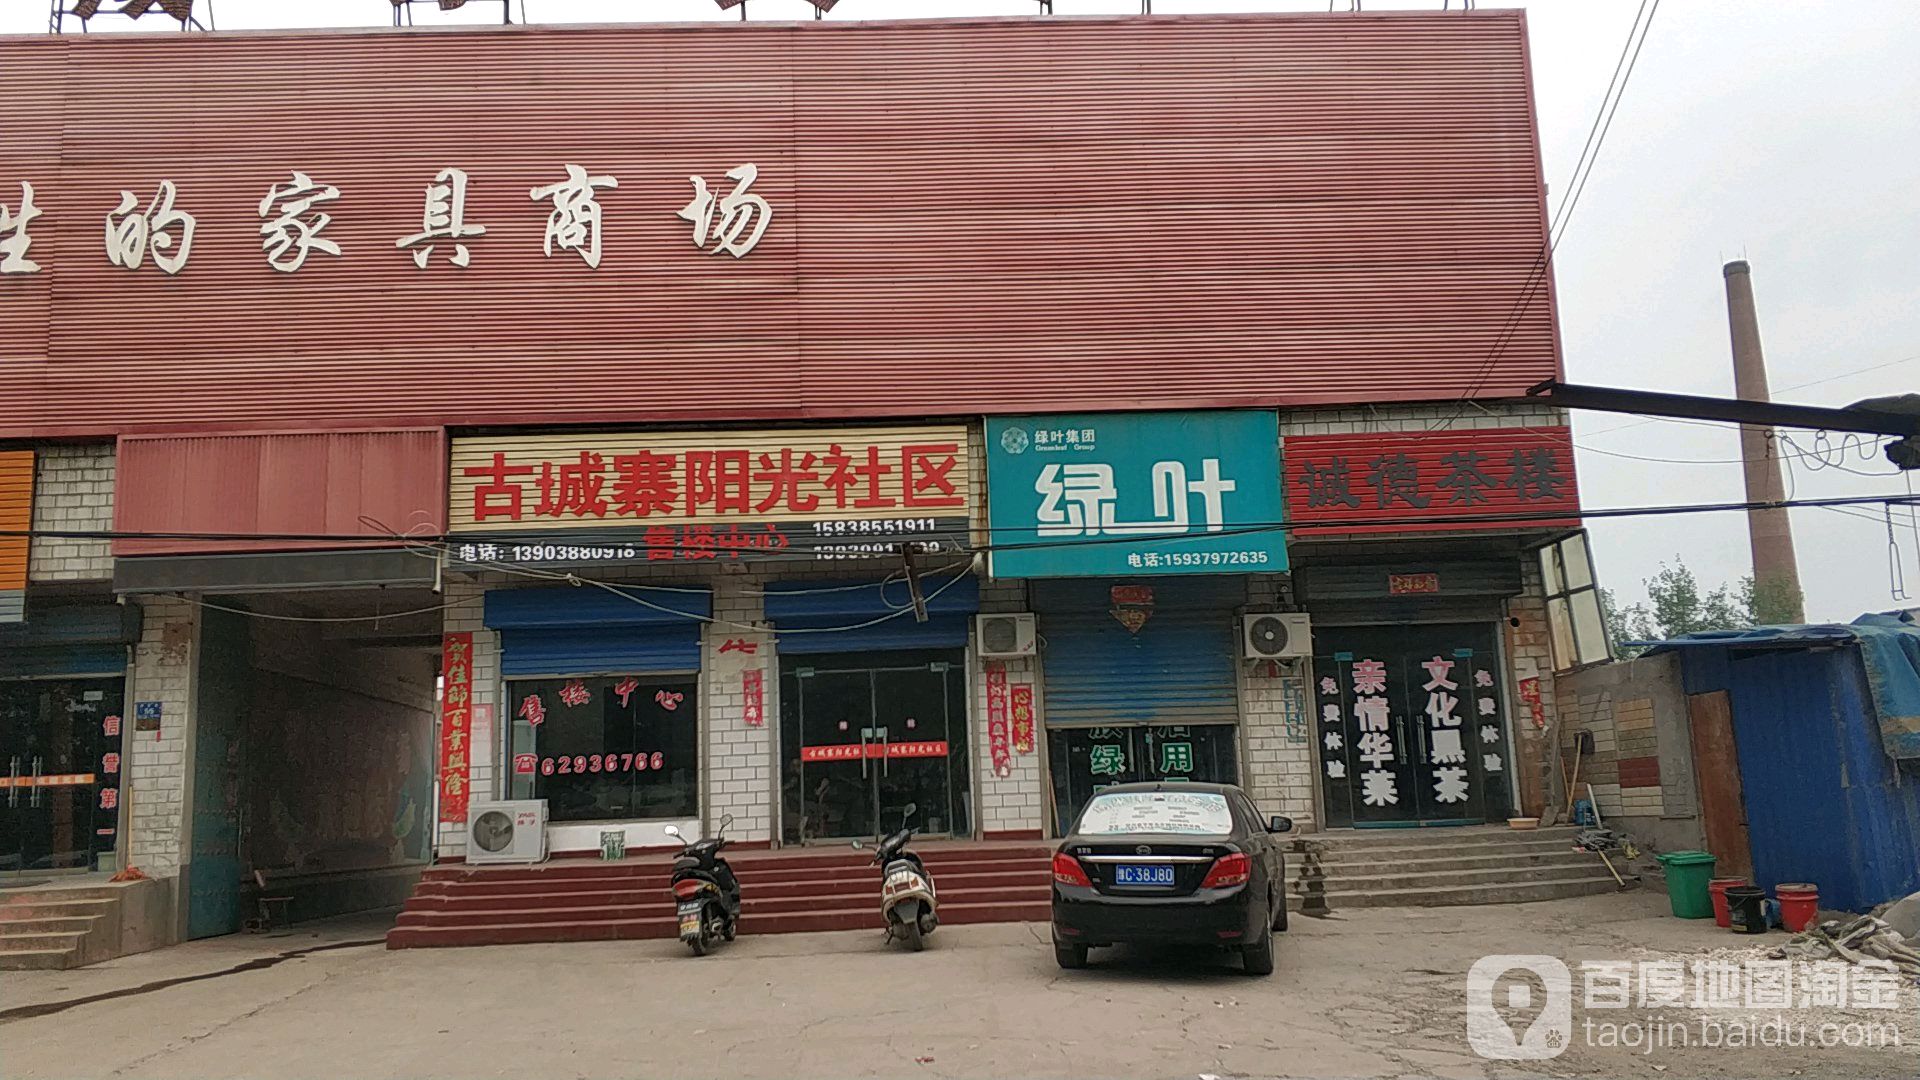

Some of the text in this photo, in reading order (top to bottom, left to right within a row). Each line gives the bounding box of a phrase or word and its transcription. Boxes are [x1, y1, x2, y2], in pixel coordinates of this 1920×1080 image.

[1034, 429, 1095, 443] 绿叶集团
[464, 443, 964, 521] 古城寨阳光社区
[1035, 458, 1235, 536] 绿叶
[1298, 447, 1567, 509] 诚德茶楼
[812, 518, 936, 537] 15838551911
[1421, 655, 1469, 803] 文化黑茶
[541, 751, 664, 776] 62936766
